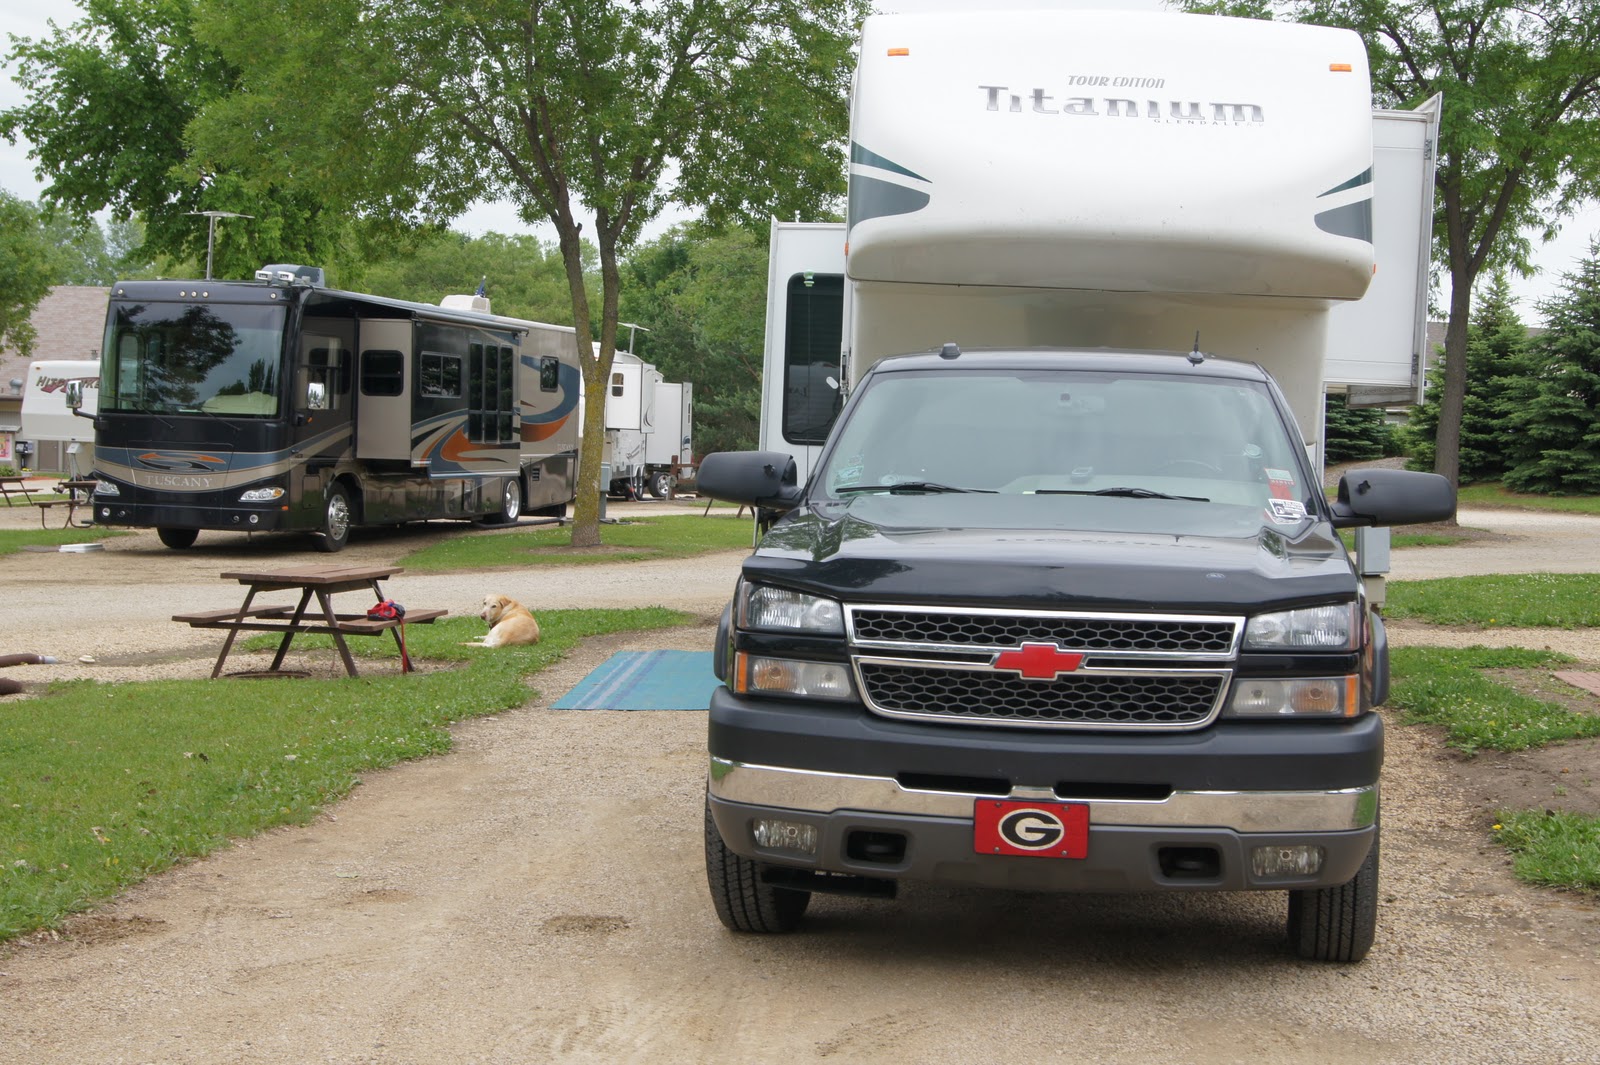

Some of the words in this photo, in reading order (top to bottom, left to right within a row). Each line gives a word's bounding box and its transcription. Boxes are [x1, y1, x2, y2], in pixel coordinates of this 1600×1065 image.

[1067, 75, 1110, 87] TOUR
[1112, 76, 1165, 89] EDITION
[977, 84, 1265, 122] Titanium
[145, 474, 213, 488] TUSCANY
[1000, 810, 1063, 848] G
